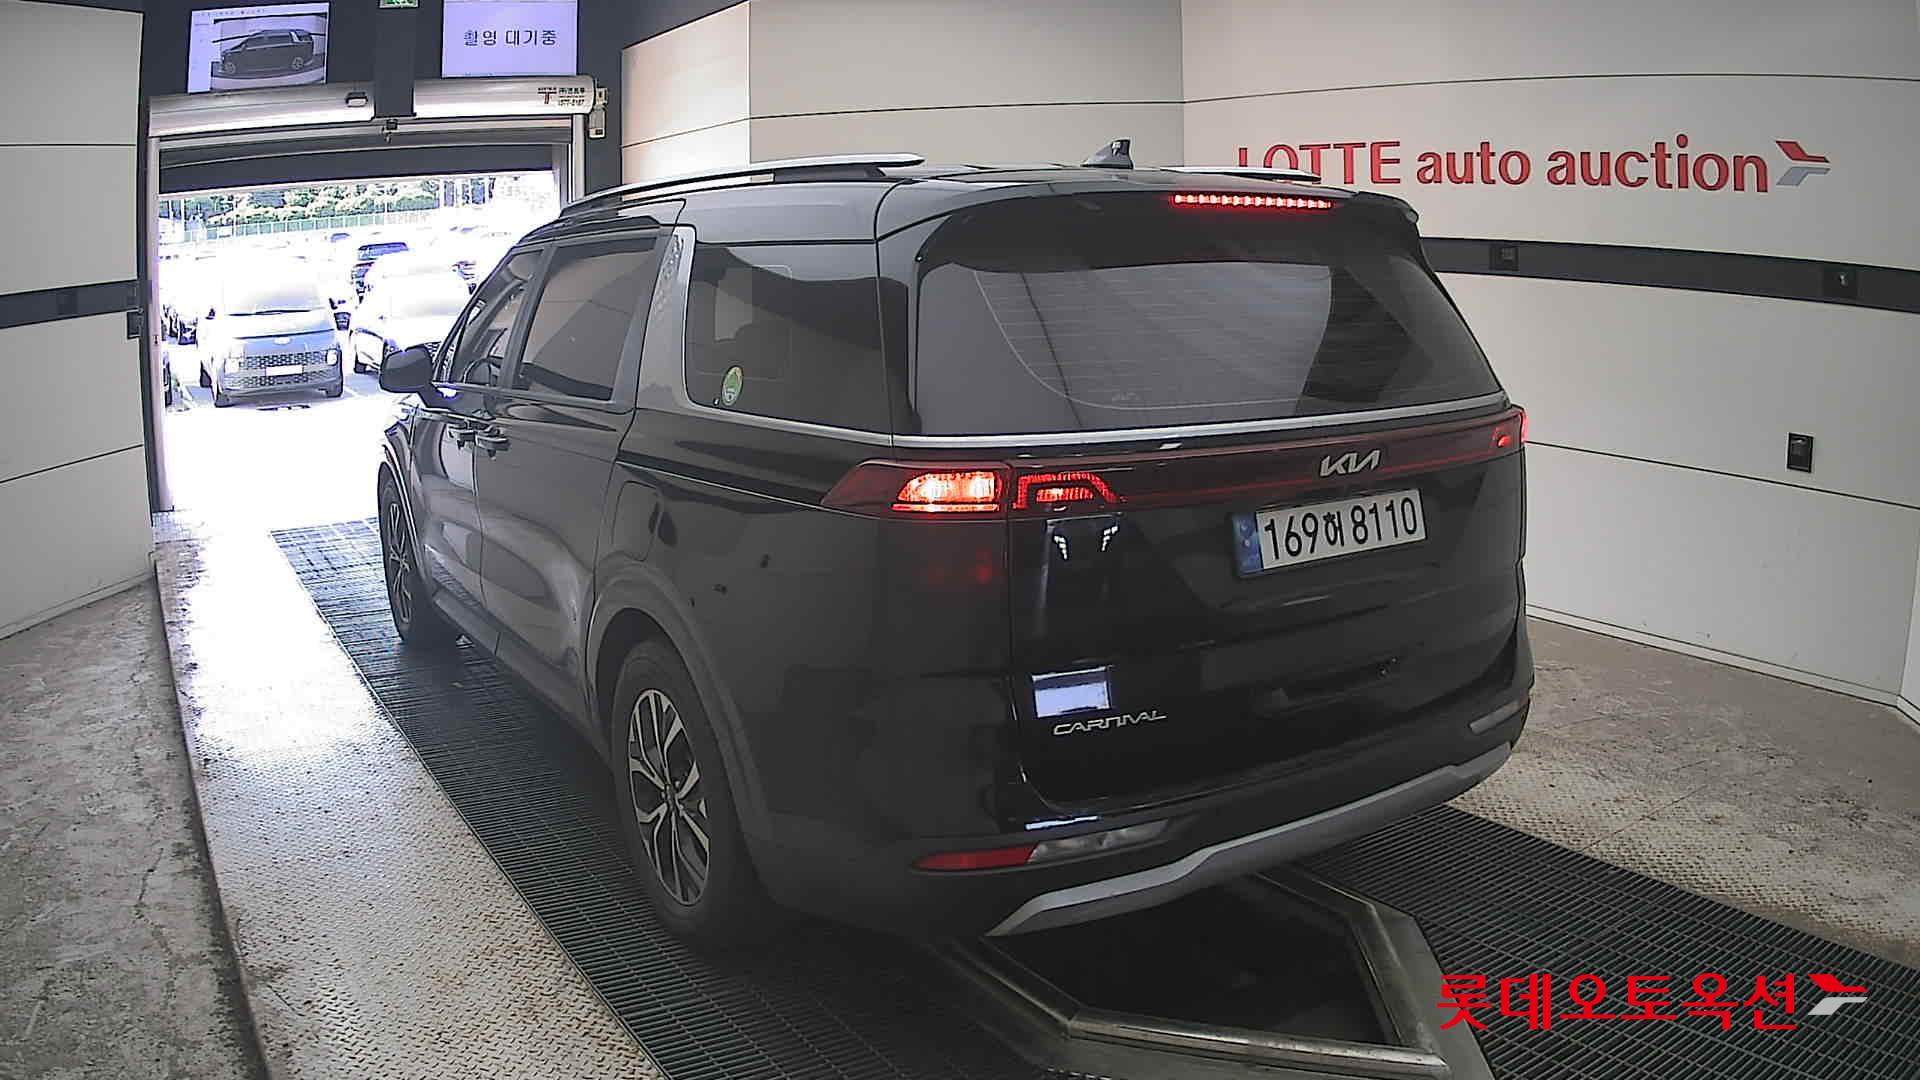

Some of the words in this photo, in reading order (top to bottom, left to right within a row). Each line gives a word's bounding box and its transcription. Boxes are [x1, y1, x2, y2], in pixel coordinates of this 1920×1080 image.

[505, 29, 558, 46] 대기중
[1416, 141, 1532, 186] auto
[1546, 133, 1769, 193] auction
[1350, 497, 1417, 545] 8110
[1053, 710, 1167, 736] CARNIVAL
